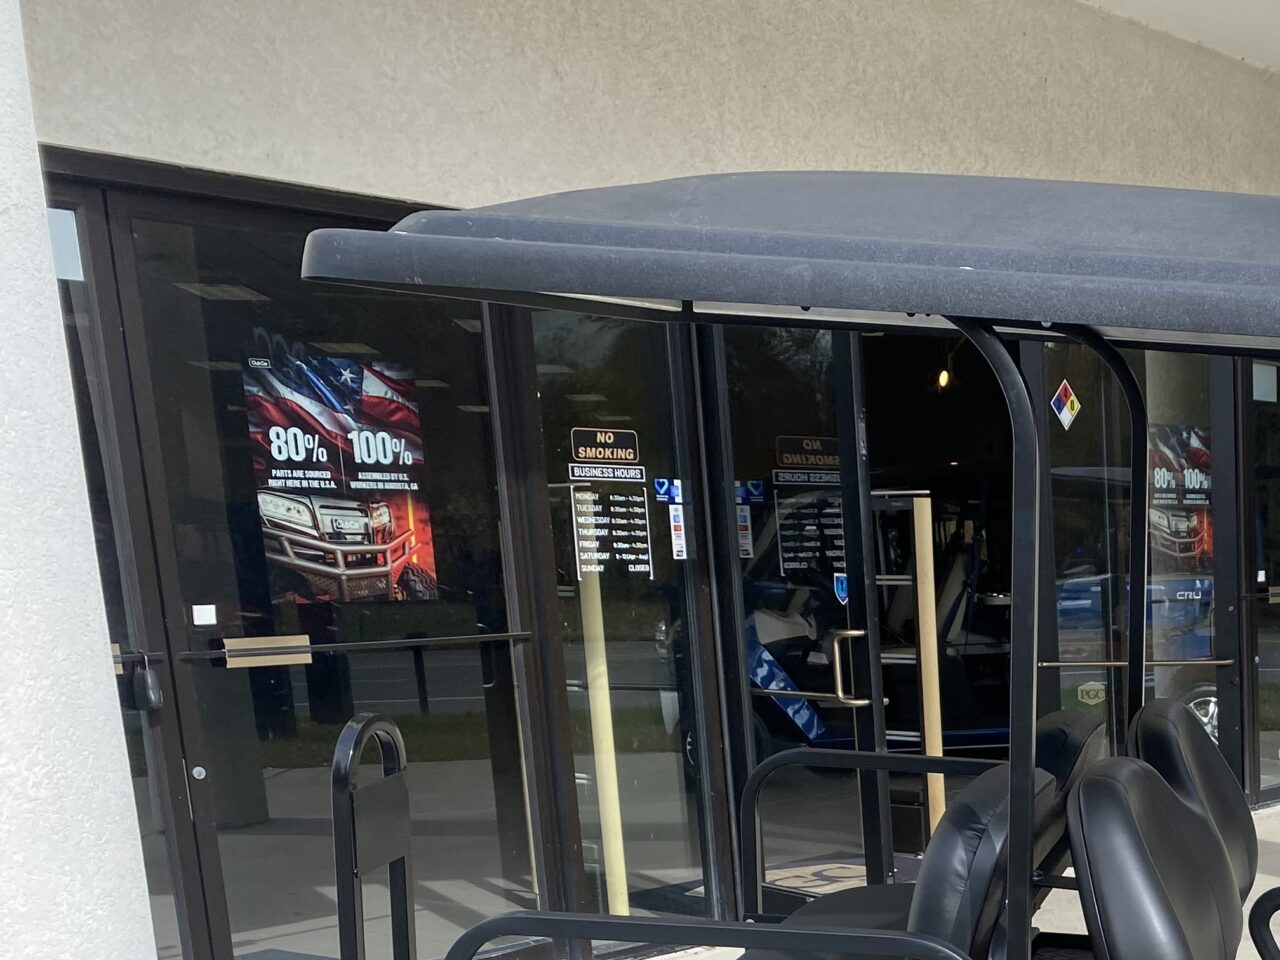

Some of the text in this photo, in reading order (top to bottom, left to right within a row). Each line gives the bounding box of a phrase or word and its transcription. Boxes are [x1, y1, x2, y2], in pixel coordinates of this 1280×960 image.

[596, 431, 614, 443] NO
[268, 425, 328, 462] 80%
[347, 430, 413, 465] 100%
[578, 446, 634, 459] SMOKING
[271, 469, 292, 478] PARTS
[292, 470, 305, 478] ARE
[573, 466, 641, 478] BUSINESS HOURS
[1153, 467, 1176, 488] 80%
[1183, 468, 1208, 489] 100%
[576, 504, 602, 512] TUESDAY
[578, 528, 608, 536] THURSDAY
[579, 540, 600, 548] FRIDAY
[581, 564, 649, 572] SUNDAY CLOSED
[1176, 591, 1202, 599] CRU
[1080, 688, 1105, 701] PGC
